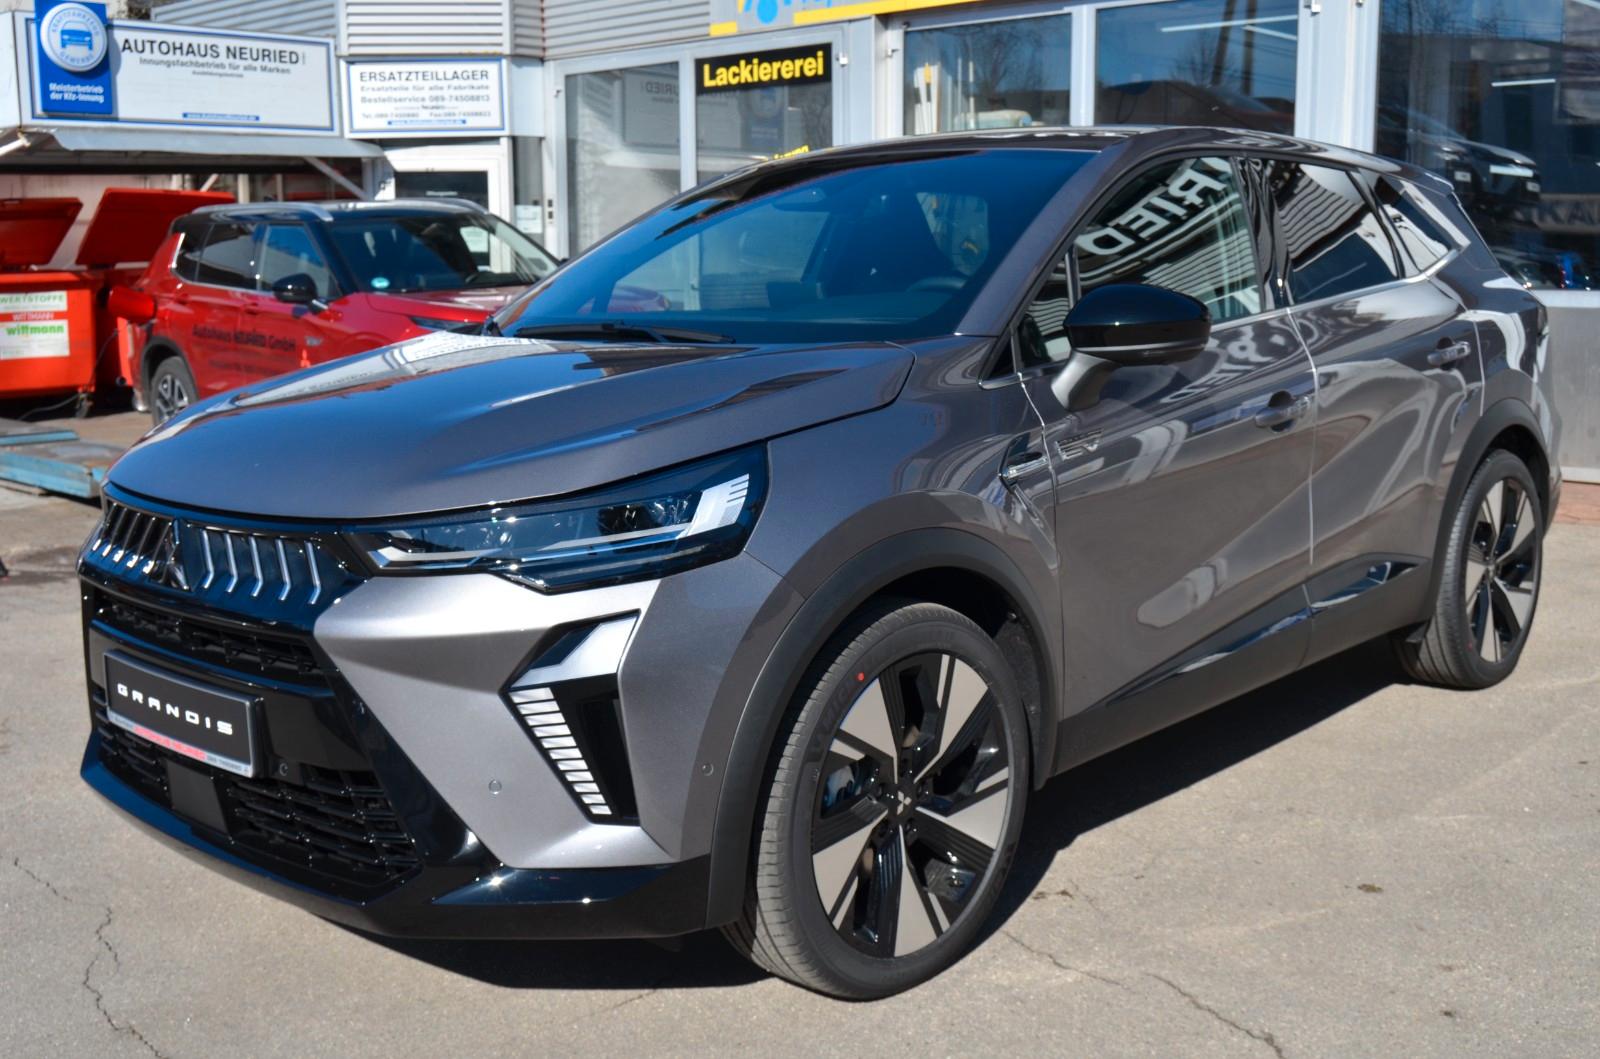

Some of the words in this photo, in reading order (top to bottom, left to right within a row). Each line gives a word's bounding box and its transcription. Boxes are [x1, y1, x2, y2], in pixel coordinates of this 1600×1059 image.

[121, 38, 221, 59] AUTOHAUS
[225, 45, 300, 65] NEURIED
[228, 59, 241, 70] für
[243, 62, 258, 72] alle
[260, 65, 292, 75] Marken
[359, 69, 490, 82] ERSATZTEILLAGER
[704, 51, 823, 88] Lackiererei
[360, 95, 426, 103] Bestellservice
[117, 682, 233, 736] GRANDIS
